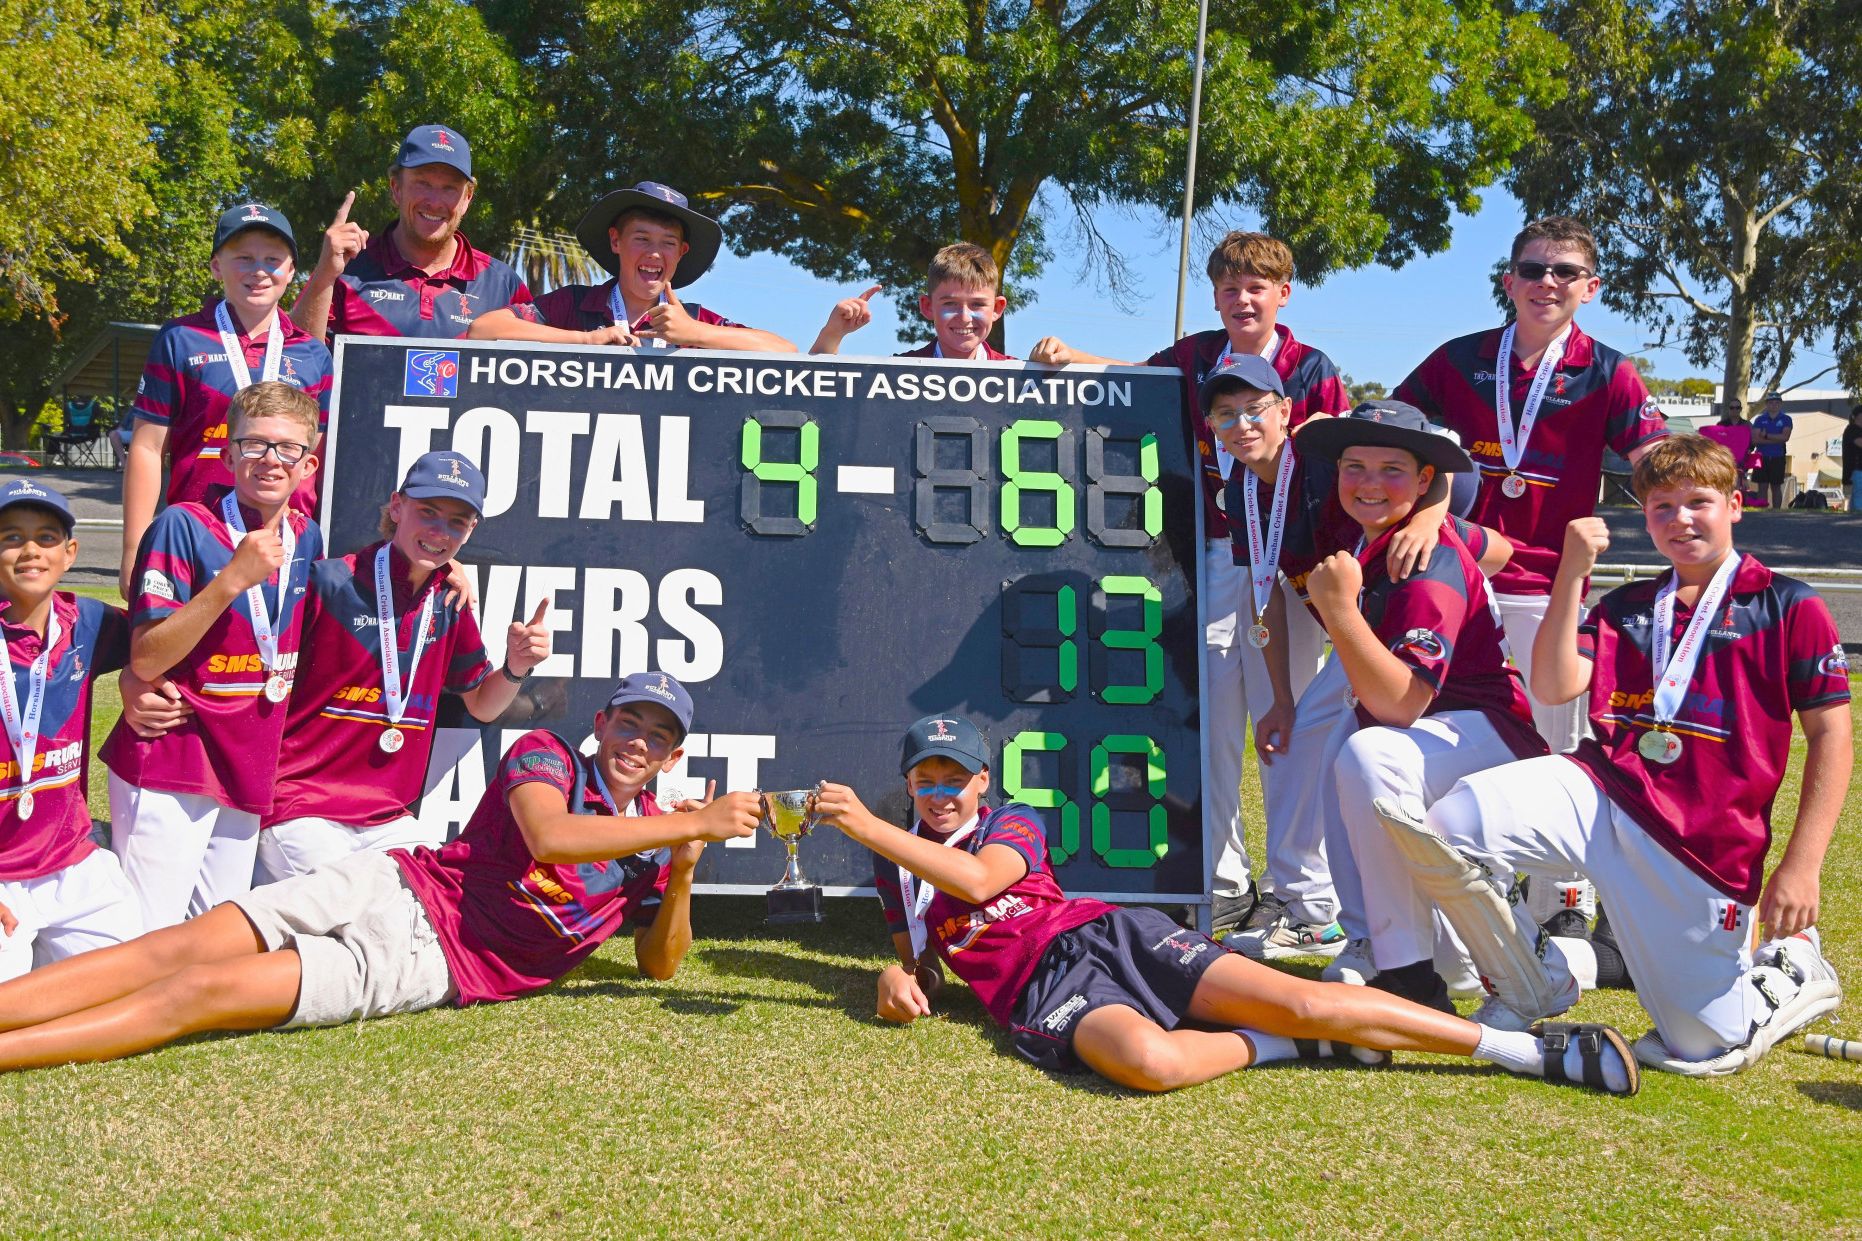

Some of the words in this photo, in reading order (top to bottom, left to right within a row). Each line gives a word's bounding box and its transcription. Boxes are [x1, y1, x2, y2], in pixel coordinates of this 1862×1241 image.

[470, 356, 674, 391] HORSHAM
[687, 366, 862, 400] CRICKET
[866, 371, 1132, 407] ASSOCIATION
[1526, 381, 1543, 416] Horsham
[203, 424, 227, 442] SM
[383, 405, 704, 523] TOTAL
[742, 417, 820, 526] 4
[1000, 419, 1163, 538] 61
[1280, 453, 1293, 498] Association
[1247, 486, 1255, 518] Cricket
[1274, 500, 1284, 528] Cricket
[1249, 519, 1260, 565] Association
[1269, 531, 1280, 566] Horsham
[378, 556, 386, 593] Horsham
[380, 594, 388, 625] Cricket
[383, 627, 392, 675] Association
[462, 565, 724, 684] VERS
[1057, 577, 1165, 704] 13
[1656, 630, 1664, 664] Horsham
[1677, 616, 1706, 663] Association
[208, 654, 263, 674] SMS
[0, 670, 14, 723] Association
[28, 677, 42, 720] Horsham
[333, 686, 381, 703] SMS
[1003, 731, 1168, 868] 50
[529, 867, 574, 904] SMS
[999, 901, 1028, 922] VICES
